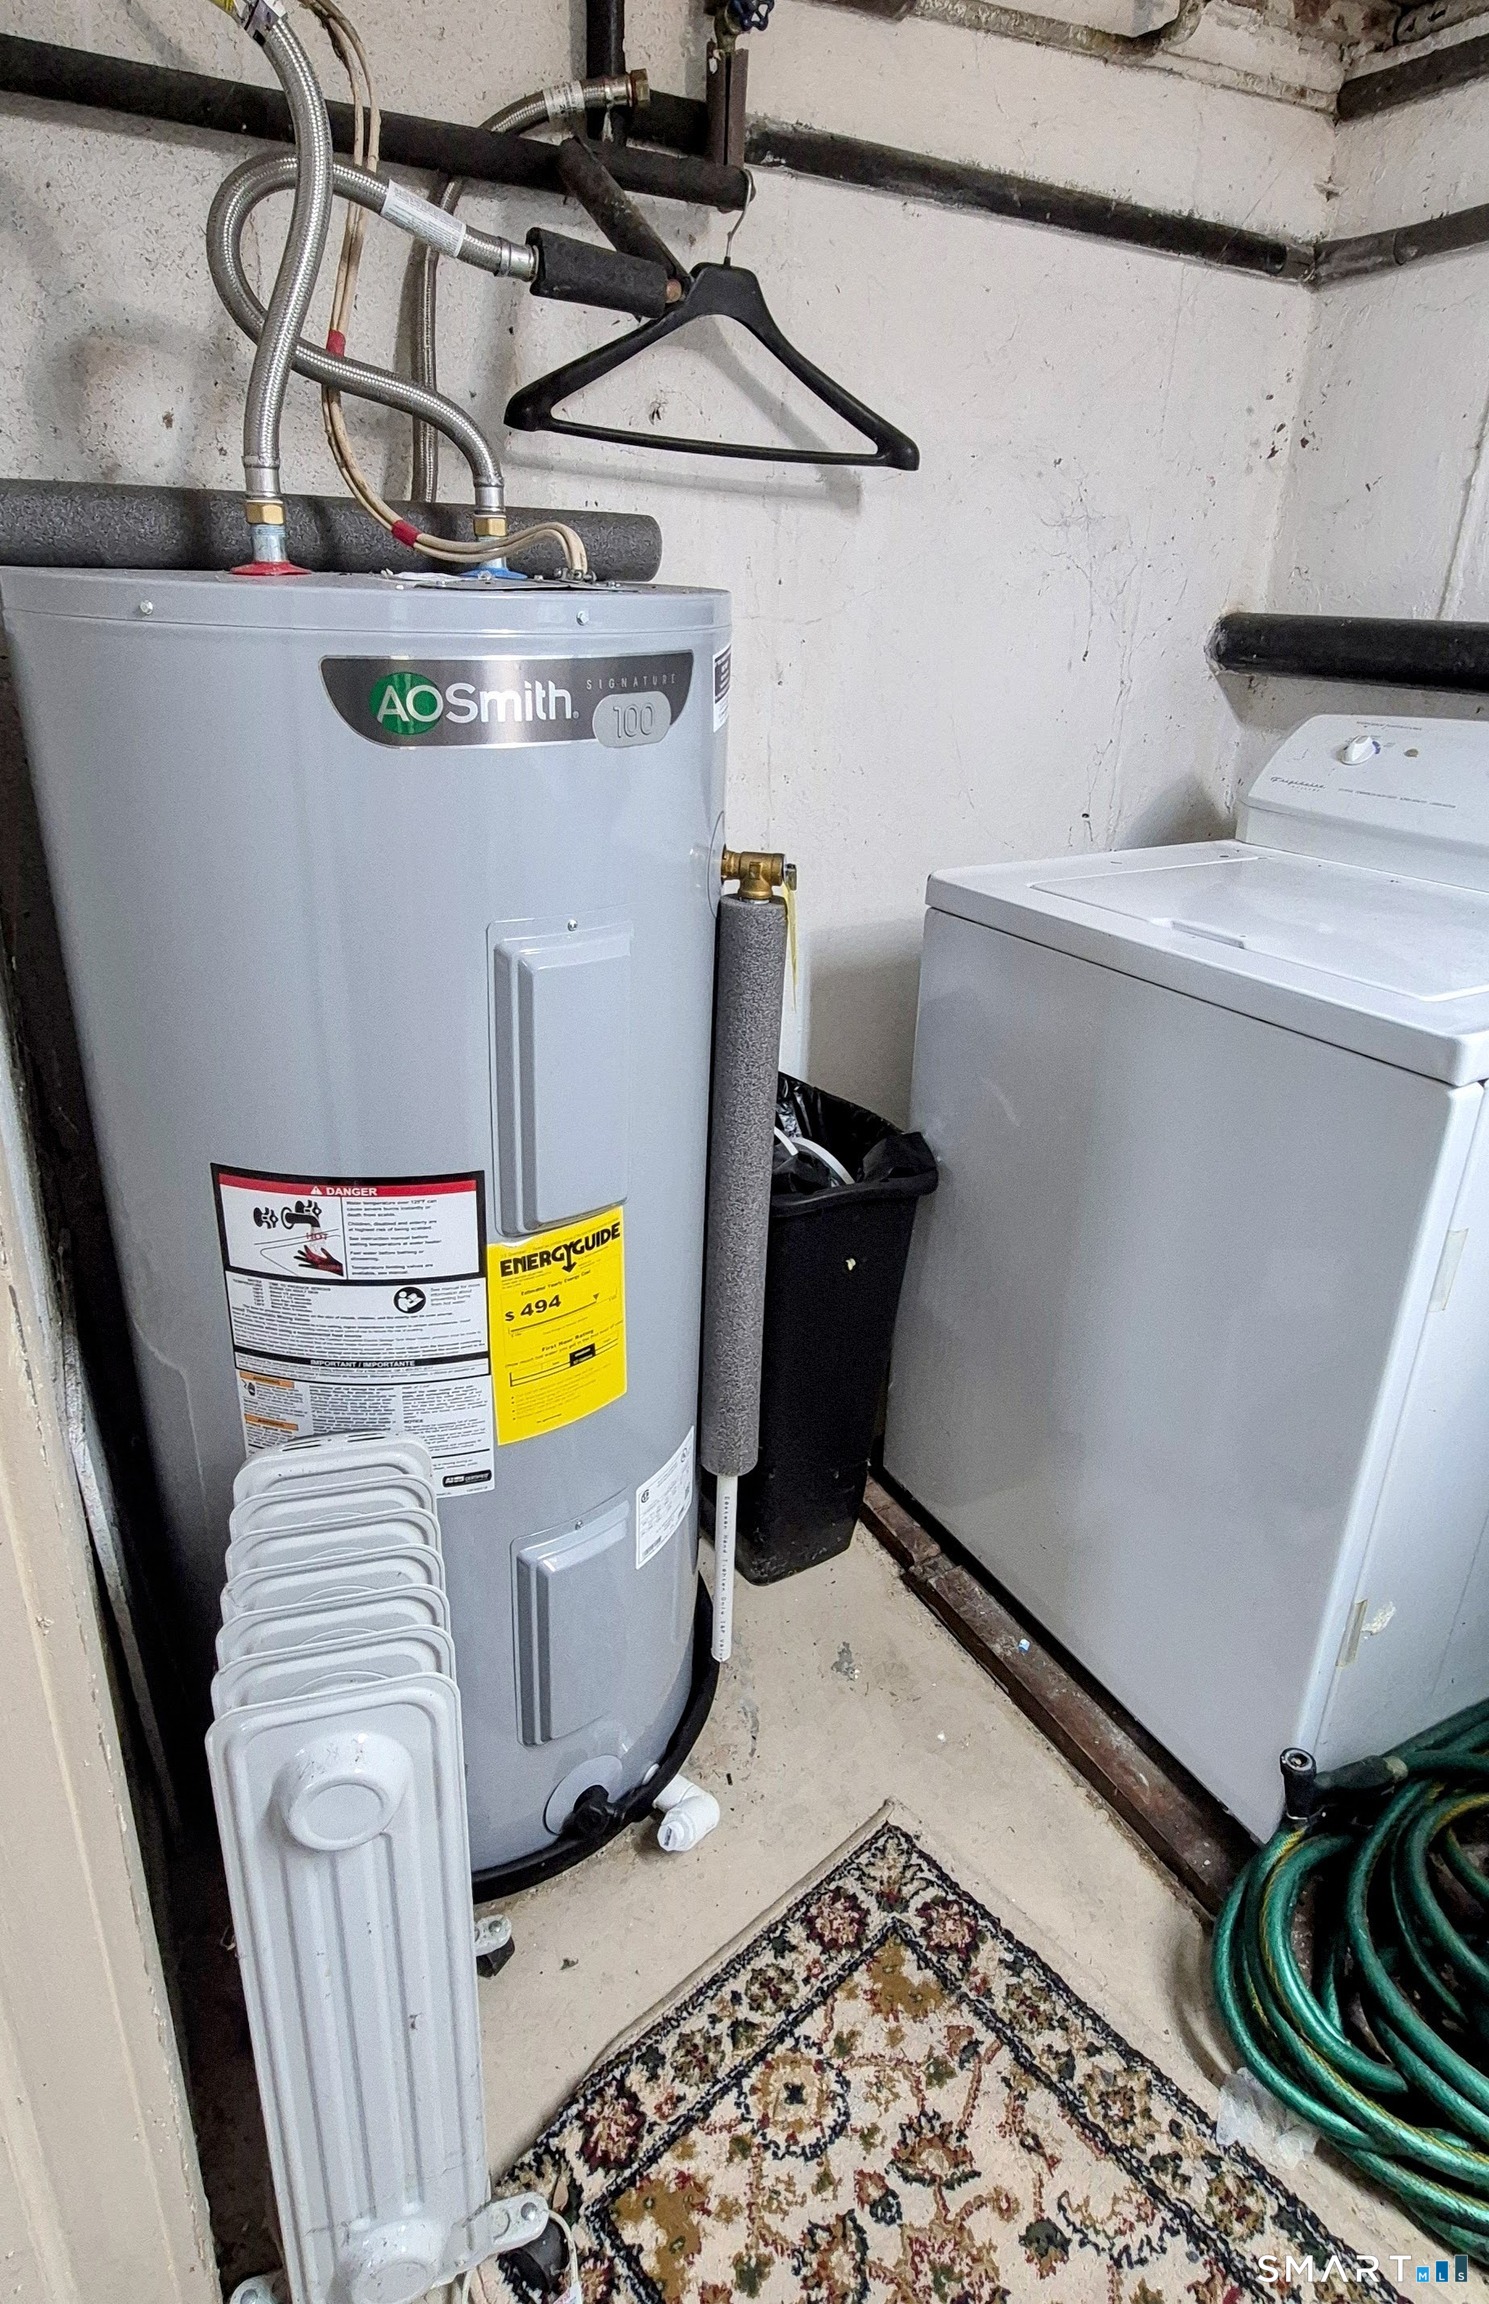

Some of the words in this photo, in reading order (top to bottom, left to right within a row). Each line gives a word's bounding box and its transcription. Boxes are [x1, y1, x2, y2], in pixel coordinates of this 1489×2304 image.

[586, 673, 676, 690] SIGNATURE
[614, 702, 655, 738] 100
[326, 1187, 378, 1196] DANGER
[500, 1221, 620, 1277] ENERGYGUIDE
[521, 1294, 561, 1316] 494
[542, 1343, 557, 1352] First
[575, 1330, 594, 1339] Rating
